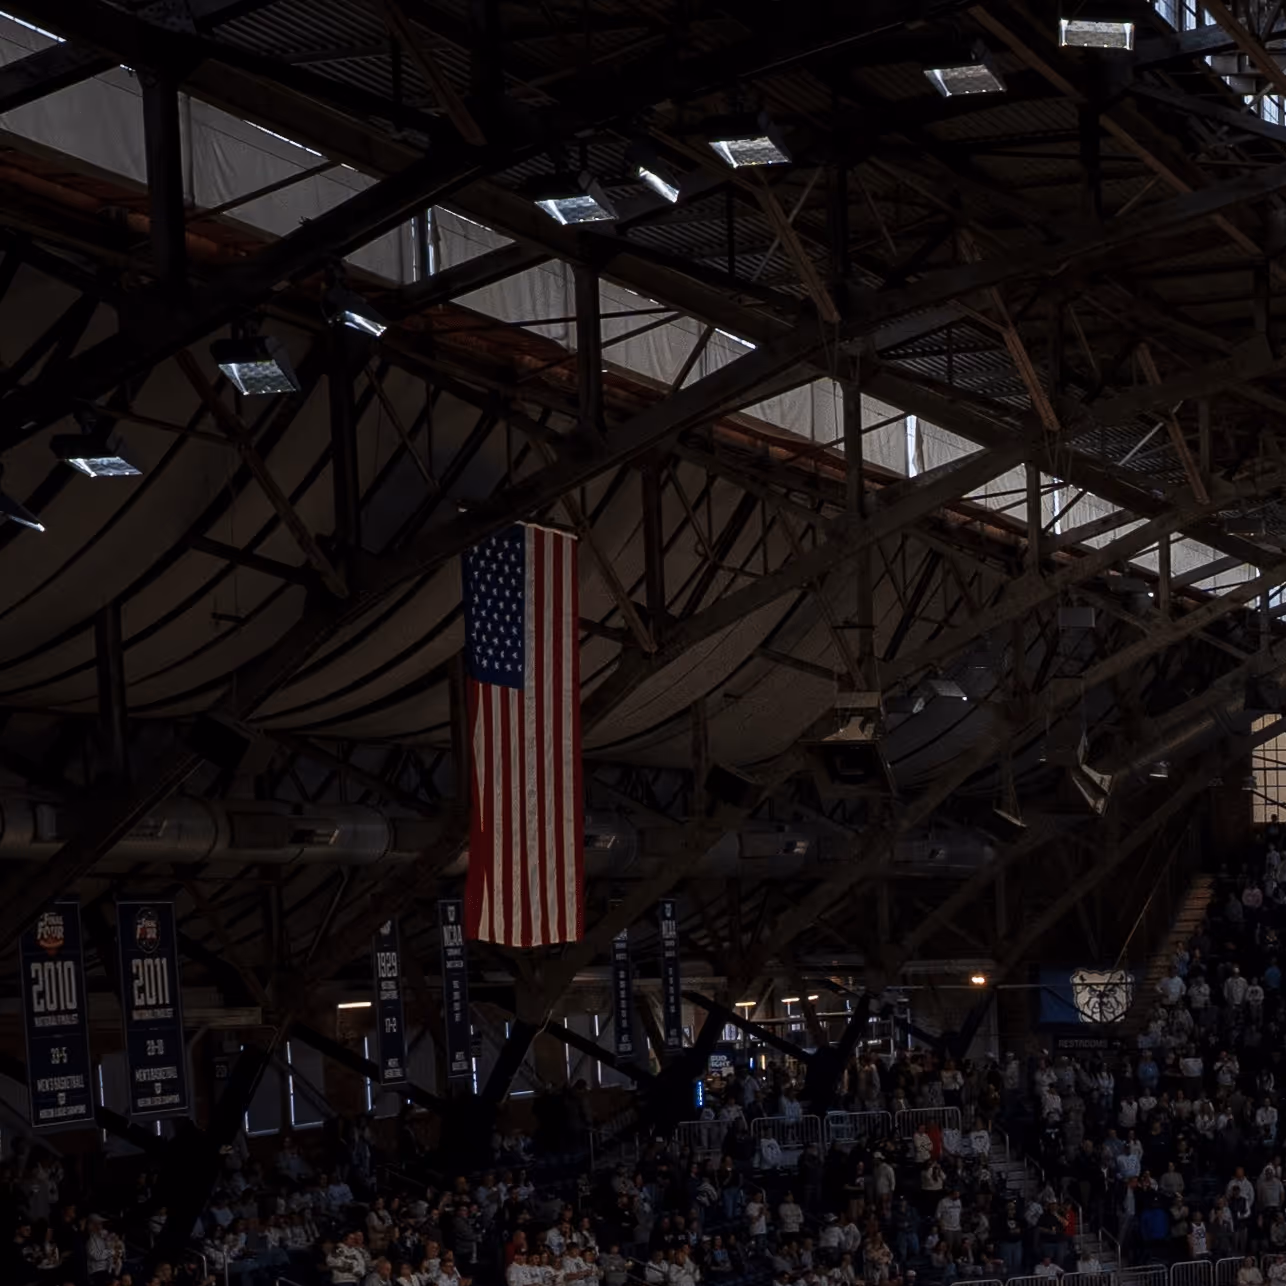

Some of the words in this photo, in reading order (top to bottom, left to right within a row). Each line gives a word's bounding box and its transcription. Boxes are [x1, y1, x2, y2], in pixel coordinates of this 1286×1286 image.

[31, 960, 77, 1013] 2010
[132, 957, 170, 1007] 2011
[377, 952, 398, 978] 1929
